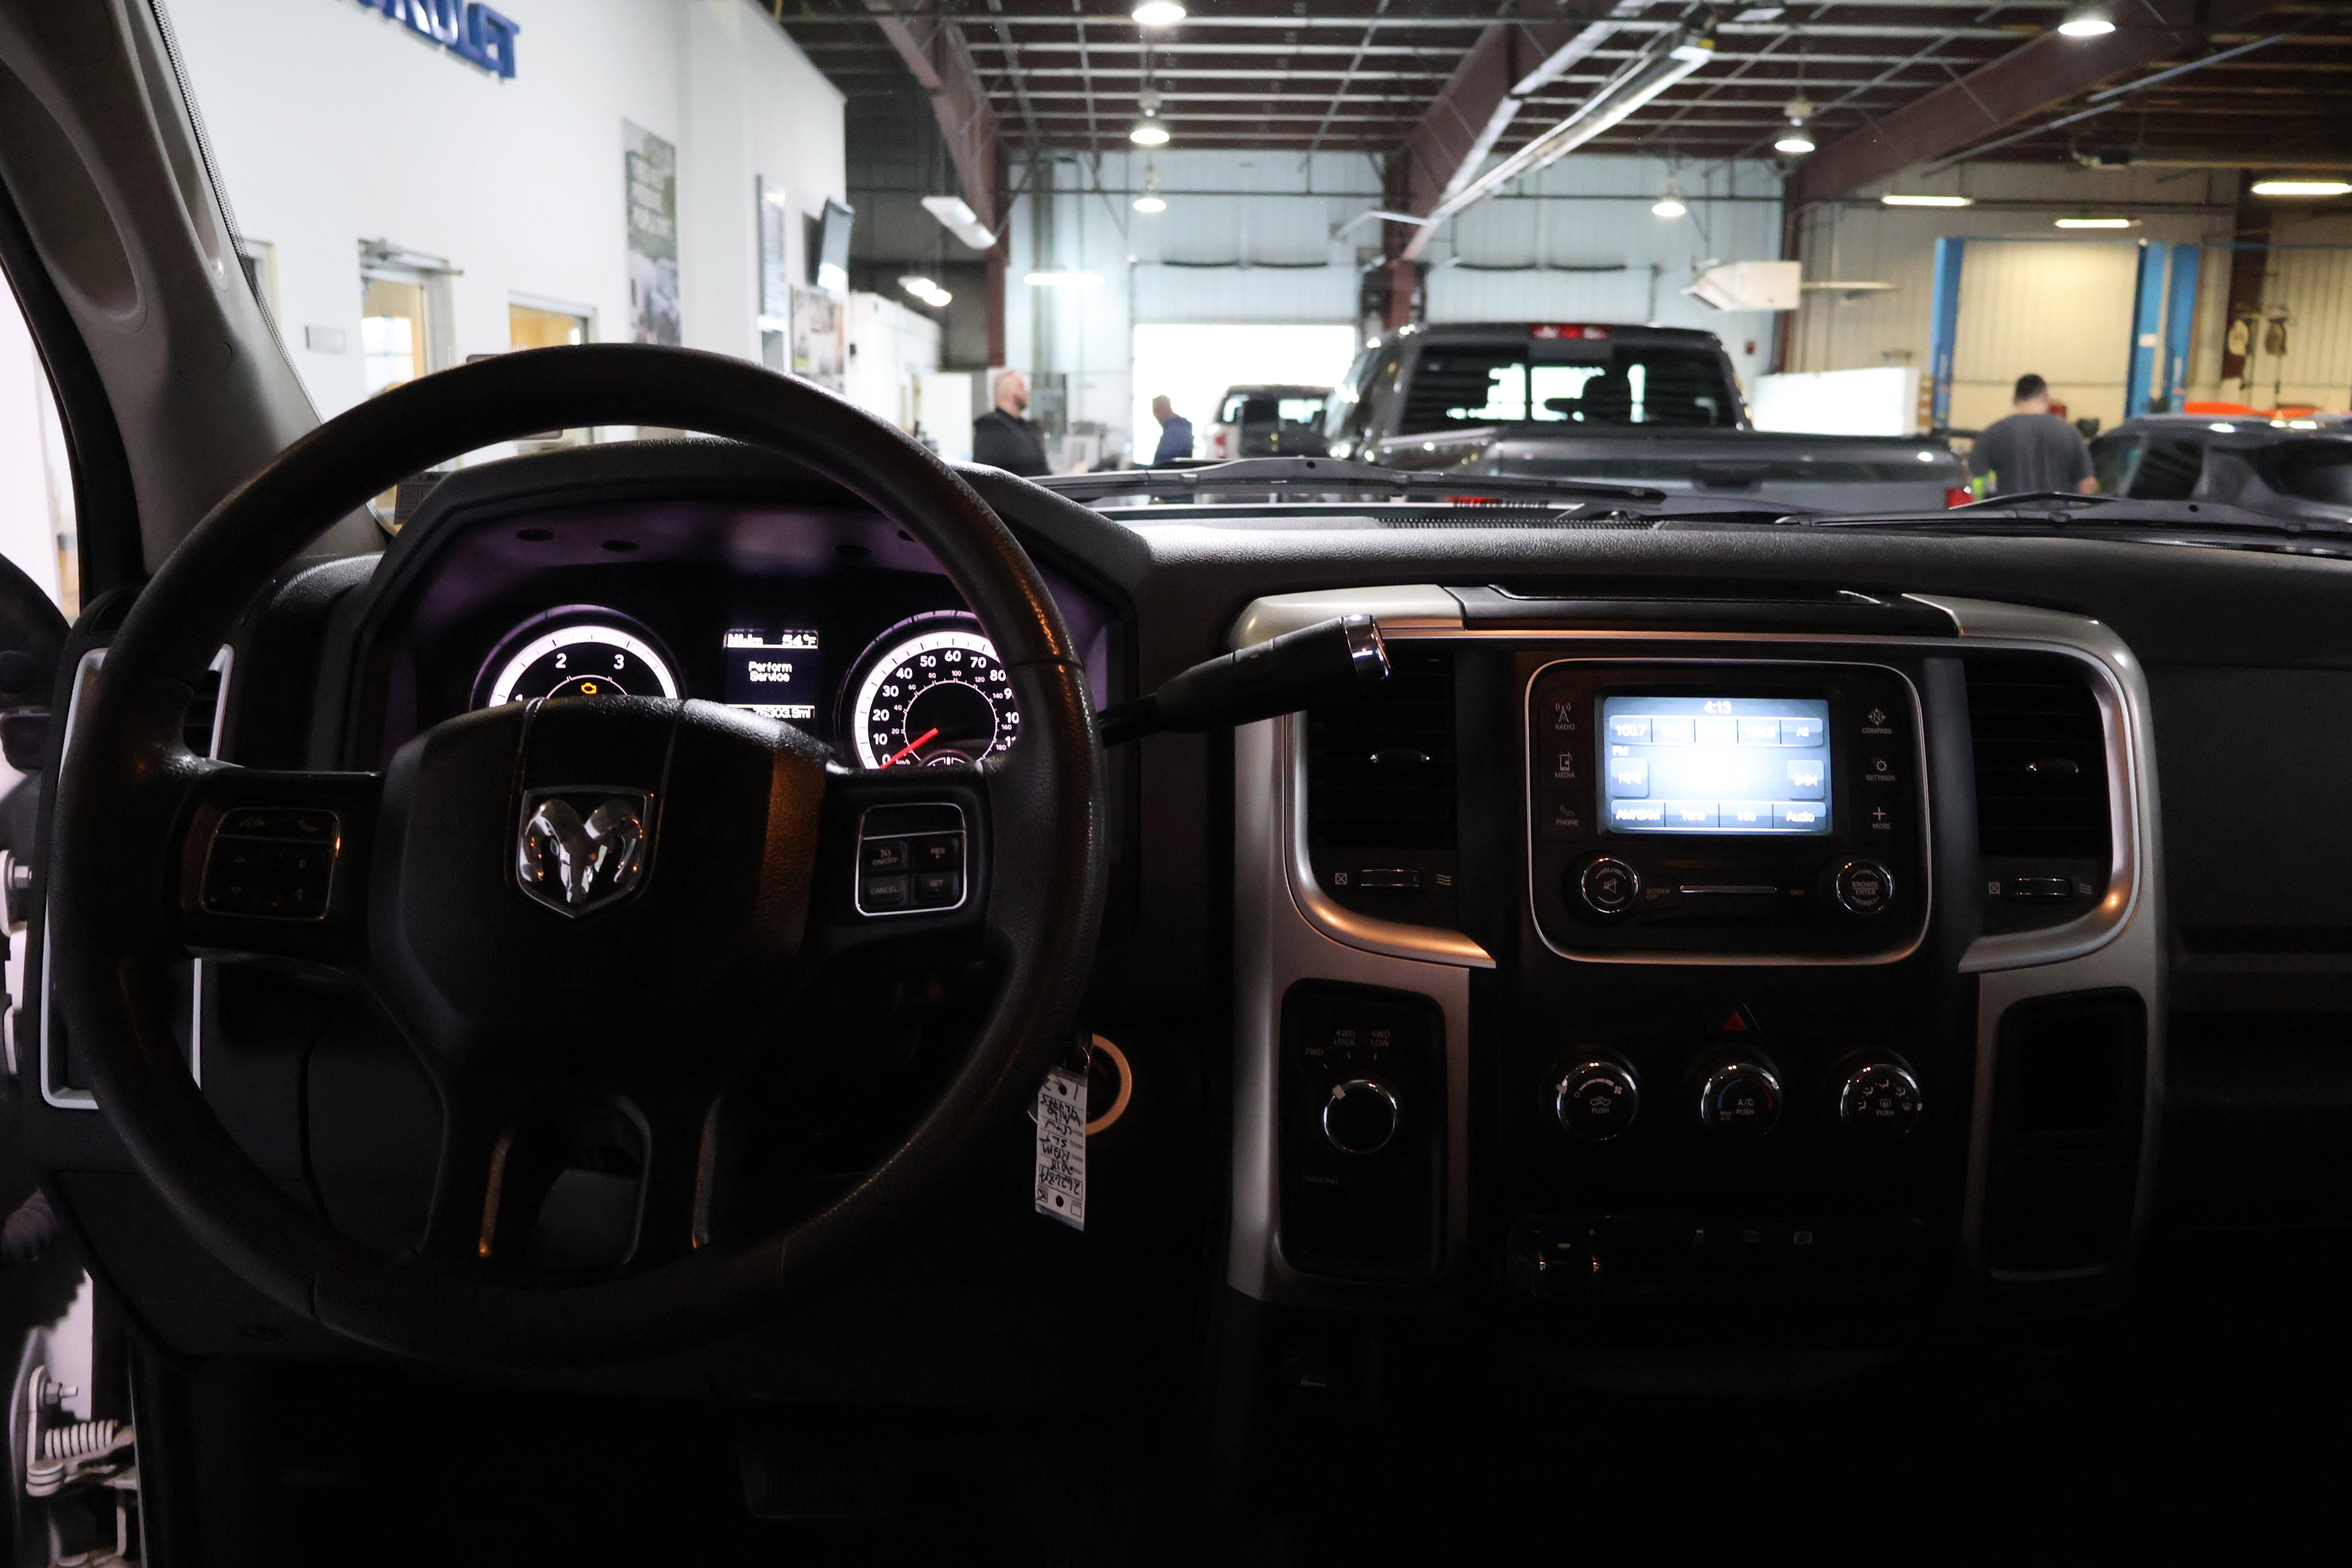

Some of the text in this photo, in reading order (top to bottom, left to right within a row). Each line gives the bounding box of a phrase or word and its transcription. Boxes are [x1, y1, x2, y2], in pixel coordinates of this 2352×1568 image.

[555, 653, 567, 669] 2
[614, 654, 624, 669] 3
[920, 656, 936, 667] 50
[944, 650, 961, 662] 60
[748, 661, 792, 672] Perform
[970, 657, 987, 668] 70
[750, 671, 790, 682] Service
[896, 668, 913, 679] 40
[990, 670, 1006, 681] 80
[882, 686, 899, 697] 30
[1004, 688, 1014, 699] 9
[1704, 701, 1731, 715] 4:13
[873, 709, 889, 721] 20
[1005, 712, 1019, 724] 10
[873, 733, 887, 745] 10
[1613, 746, 1628, 756] FM
[882, 754, 891, 765] 0
[1786, 811, 1815, 822] Audio
[1336, 1029, 1355, 1038] 4WD
[1371, 1030, 1390, 1038] 4WD
[1334, 1038, 1355, 1046] LOCK
